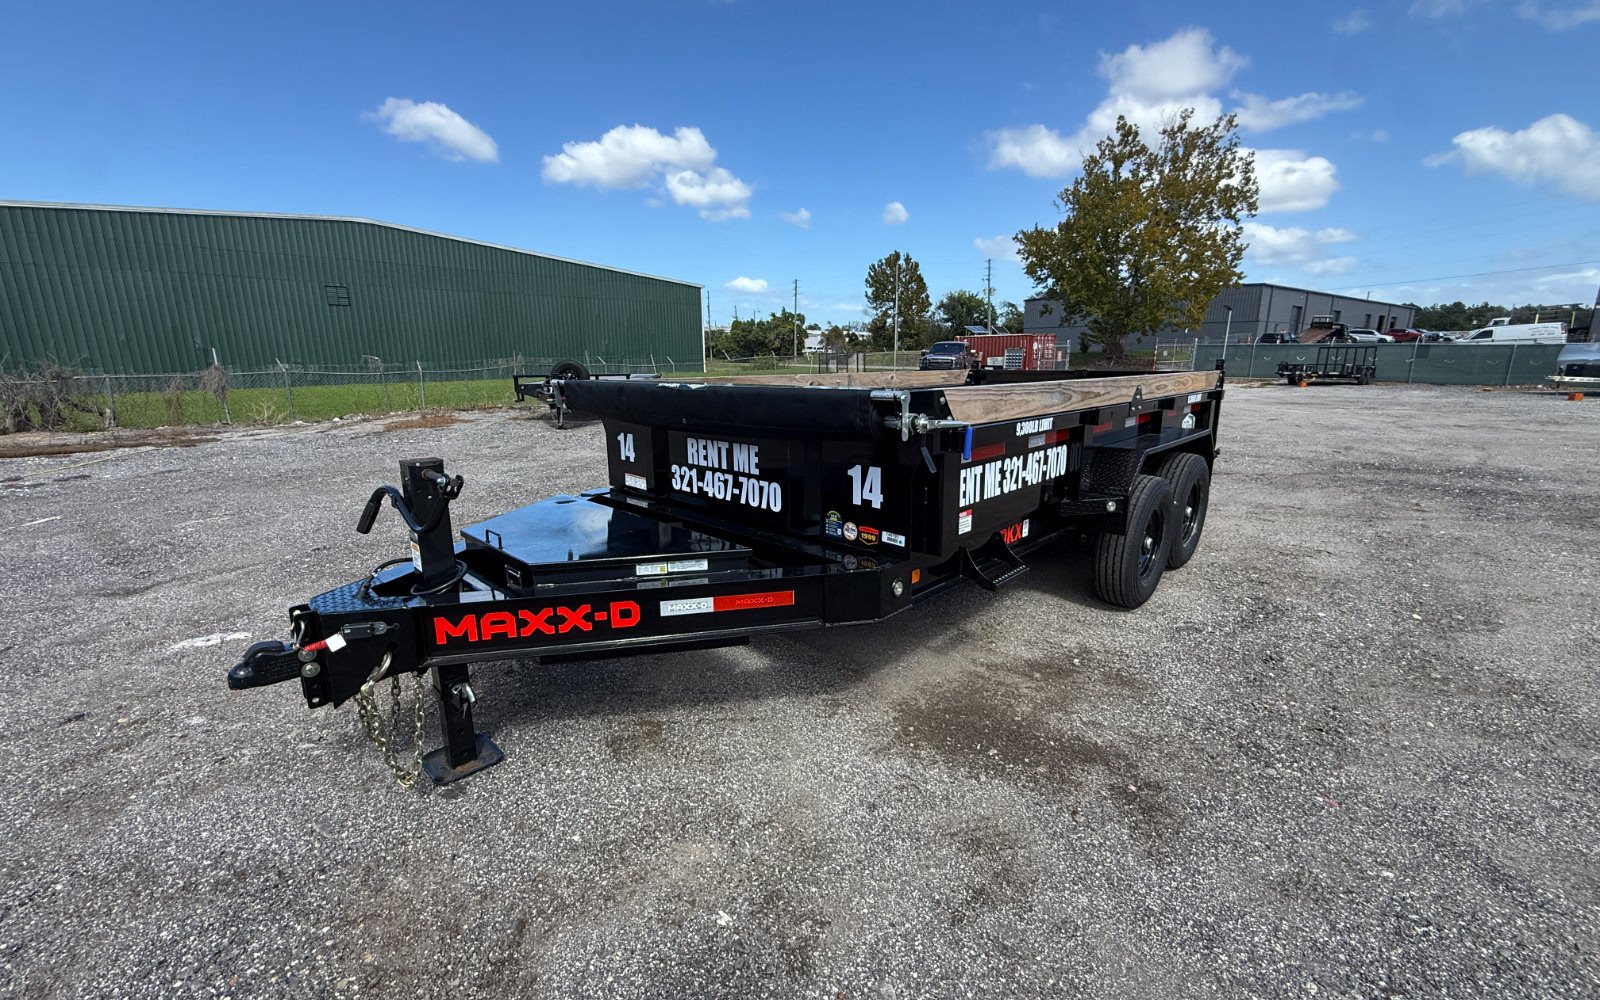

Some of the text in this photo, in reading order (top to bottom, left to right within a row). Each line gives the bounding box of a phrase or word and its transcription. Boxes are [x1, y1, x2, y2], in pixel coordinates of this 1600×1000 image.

[617, 432, 636, 463] 14
[687, 437, 759, 475] RENT ME
[671, 464, 782, 513] 321-467-7070
[847, 464, 884, 509] 14
[959, 444, 1068, 508] ENT ME 321-467-7070
[861, 532, 877, 541] 1999
[667, 602, 708, 612] MAXX-D
[735, 596, 774, 606] MAXX-D
[434, 600, 641, 645] MAXX-D
